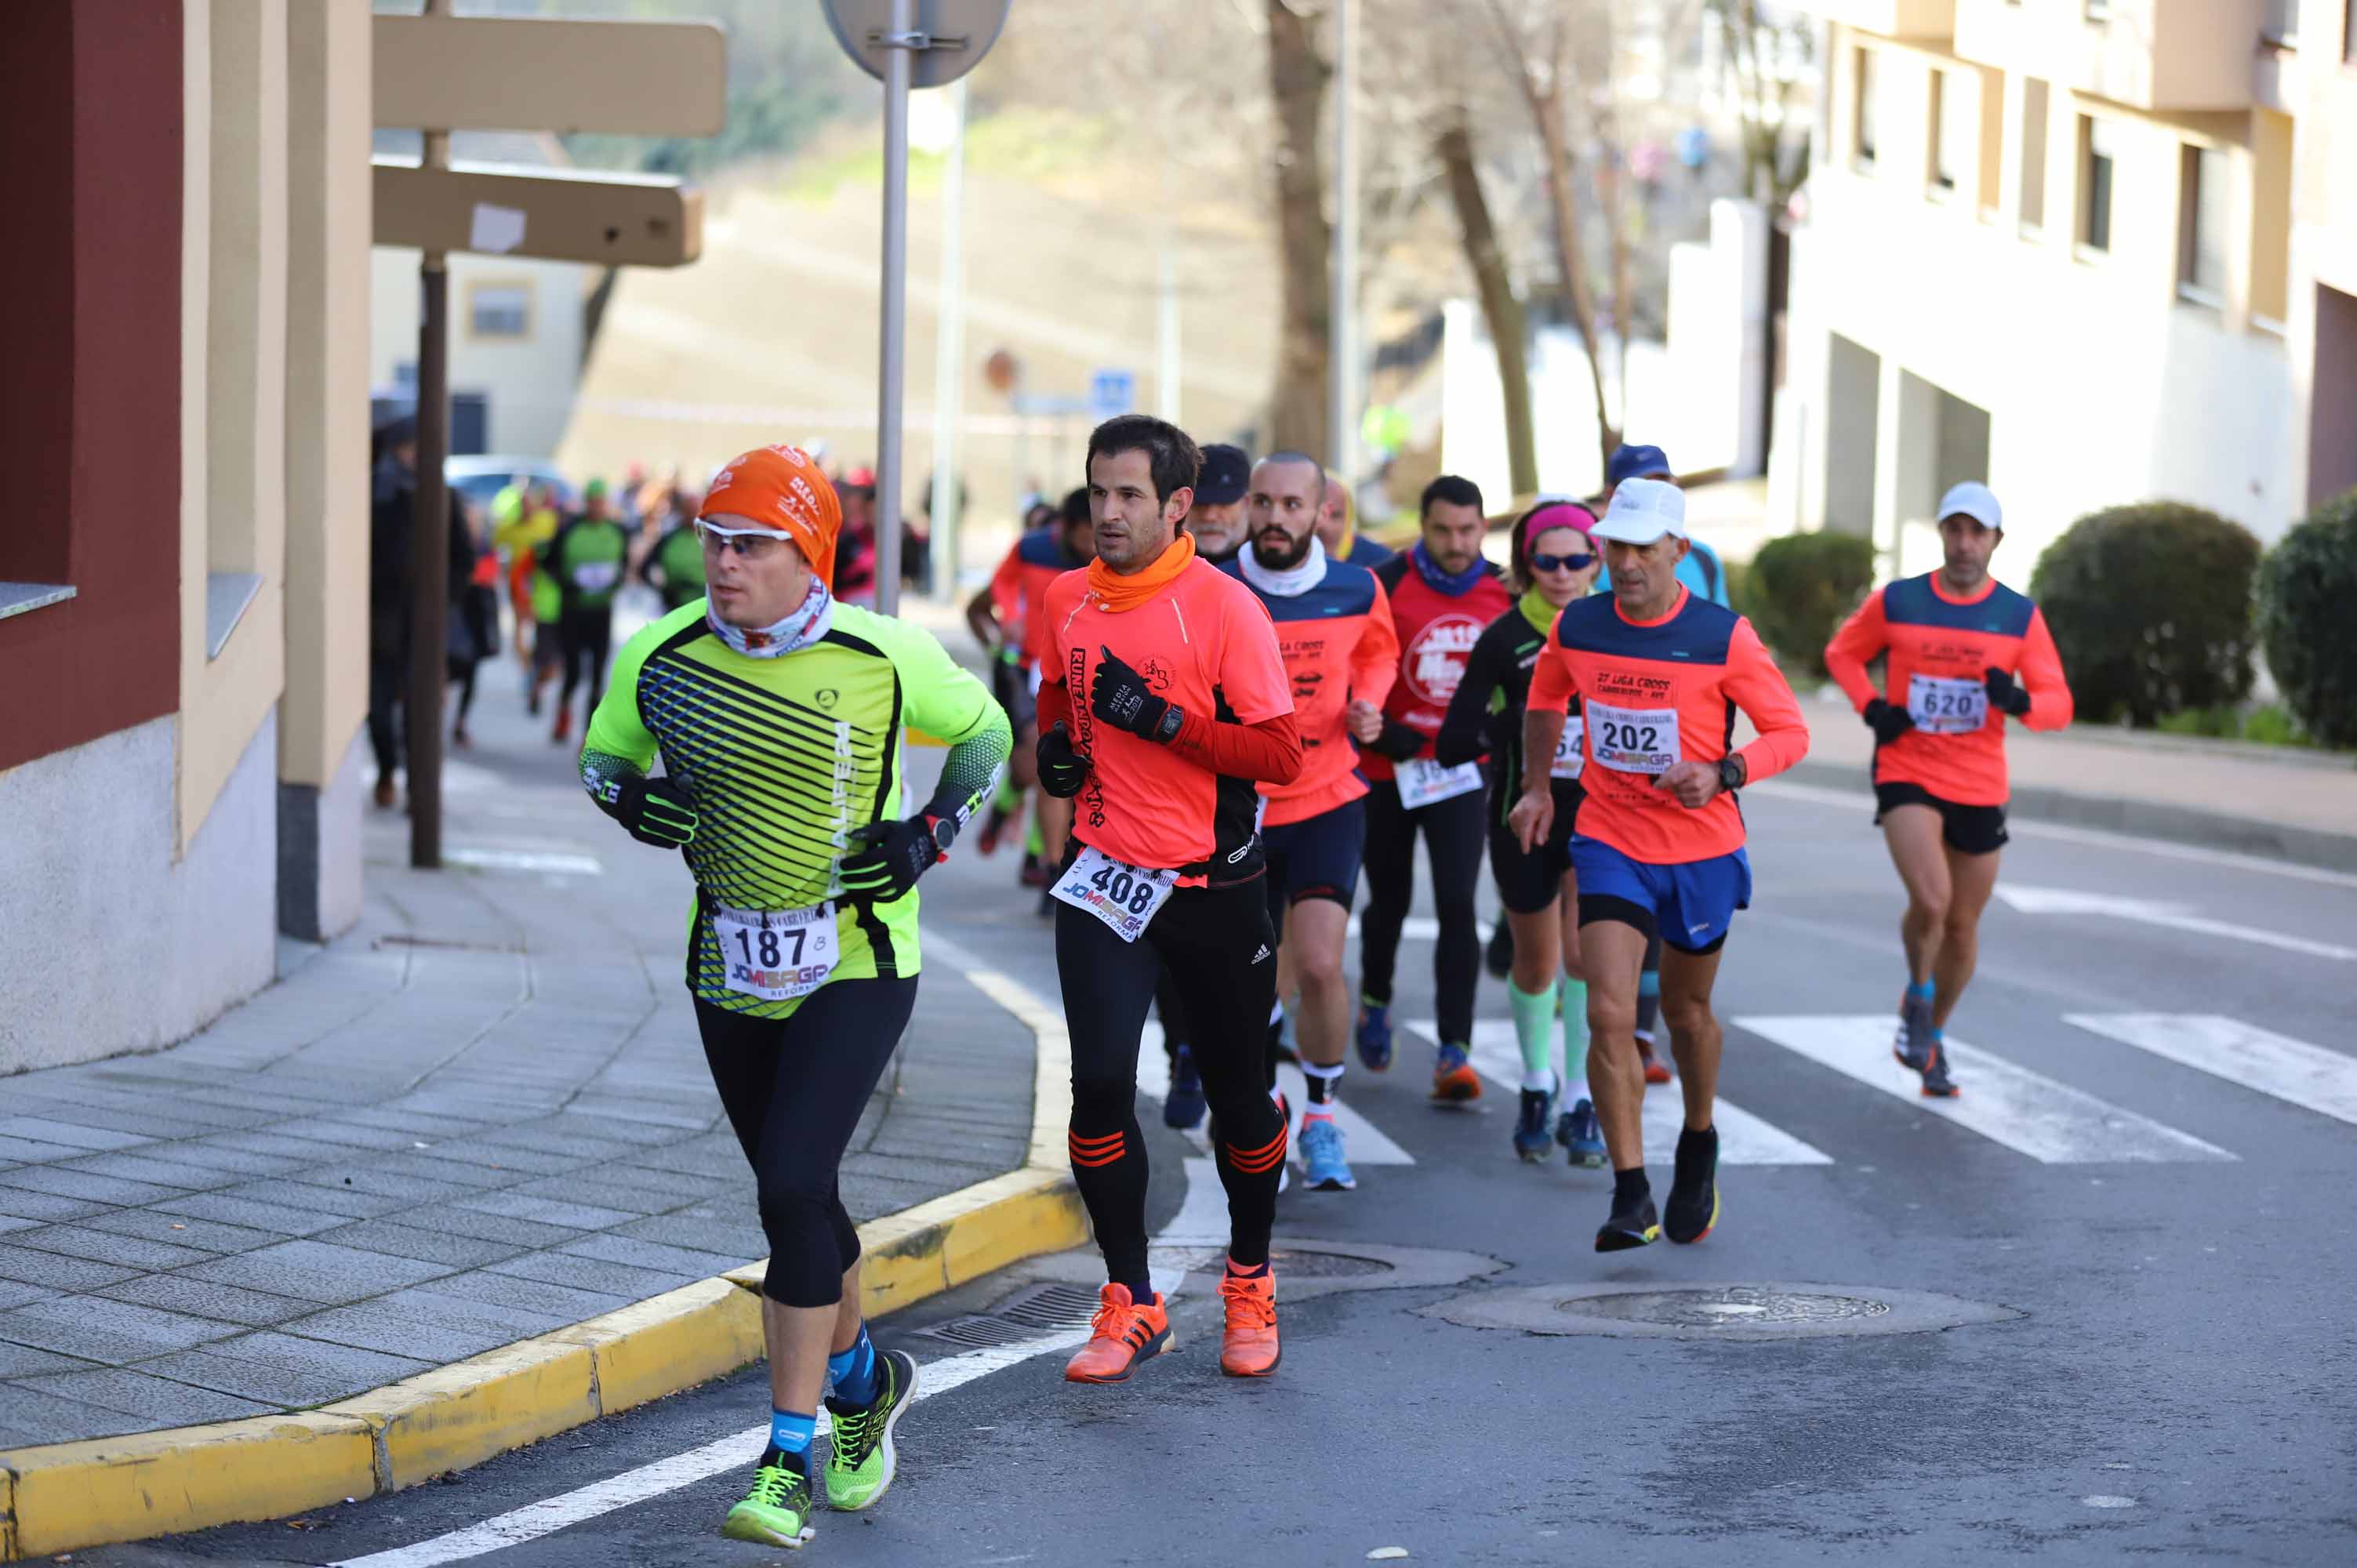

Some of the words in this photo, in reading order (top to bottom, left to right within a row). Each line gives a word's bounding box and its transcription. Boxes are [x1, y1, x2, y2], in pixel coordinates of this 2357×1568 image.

[1923, 694, 1972, 715] 620
[1603, 722, 1658, 752] 202
[1091, 866, 1153, 914] 408
[735, 928, 807, 968] 187
